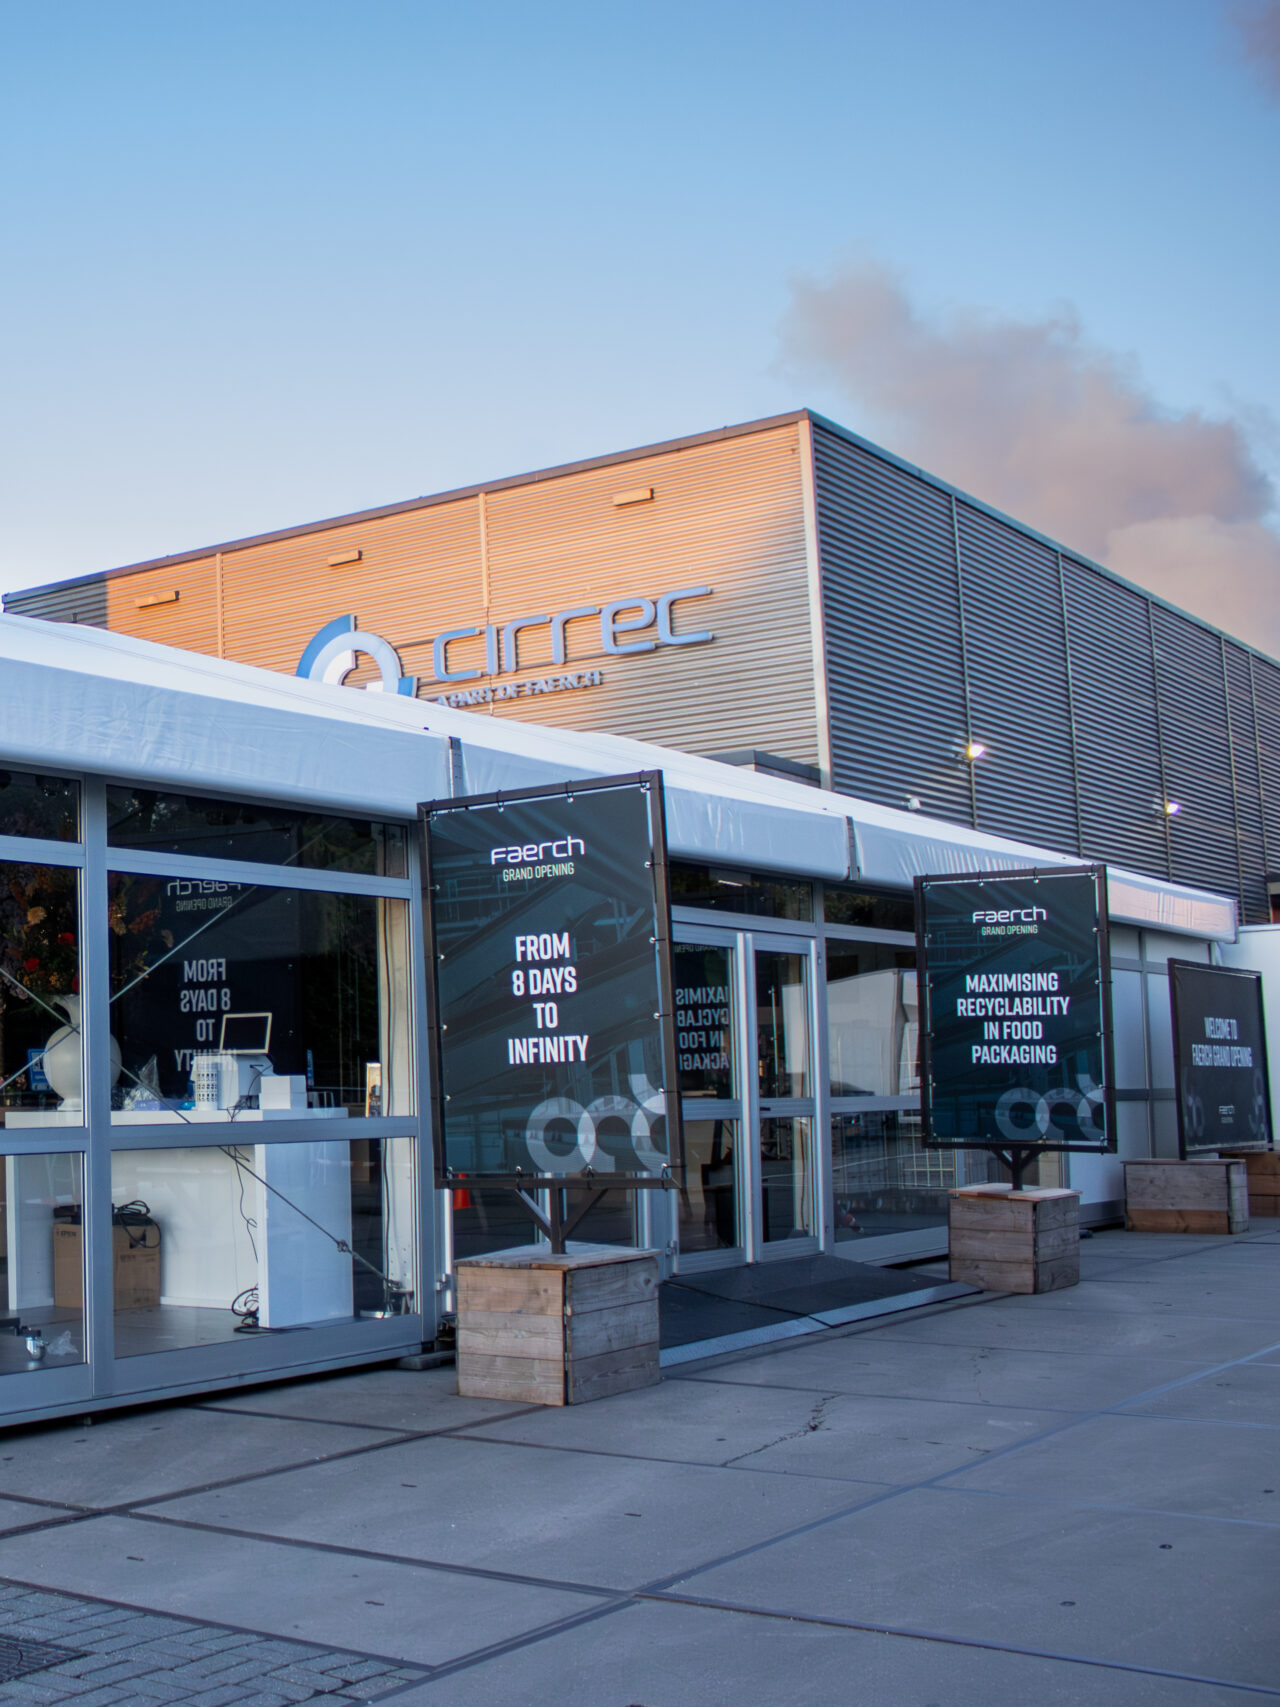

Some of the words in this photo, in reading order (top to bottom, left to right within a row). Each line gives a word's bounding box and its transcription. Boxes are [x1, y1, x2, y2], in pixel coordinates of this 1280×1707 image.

[433, 585, 713, 682] cirrec
[449, 687, 495, 708] PART
[499, 680, 522, 700] OF
[524, 670, 604, 695] FAERCH
[503, 866, 534, 882] GRAND
[535, 862, 575, 878] OPENING
[981, 926, 1006, 936] GRAND
[1007, 924, 1038, 935] OPENING
[515, 932, 570, 962] FROM
[512, 970, 525, 996] 8
[529, 966, 577, 995] DAYS
[965, 972, 1059, 993] MAXIMISING
[532, 1001, 559, 1029] TO
[956, 996, 1071, 1017] RECYCLABILITY
[983, 1021, 999, 1040] IN
[1002, 1021, 1043, 1040] FOOD
[508, 1034, 589, 1065] INFINITY
[971, 1045, 1057, 1064] PACKAGING
[1212, 1045, 1231, 1067] GRAND
[1231, 1046, 1253, 1068] OPENING
